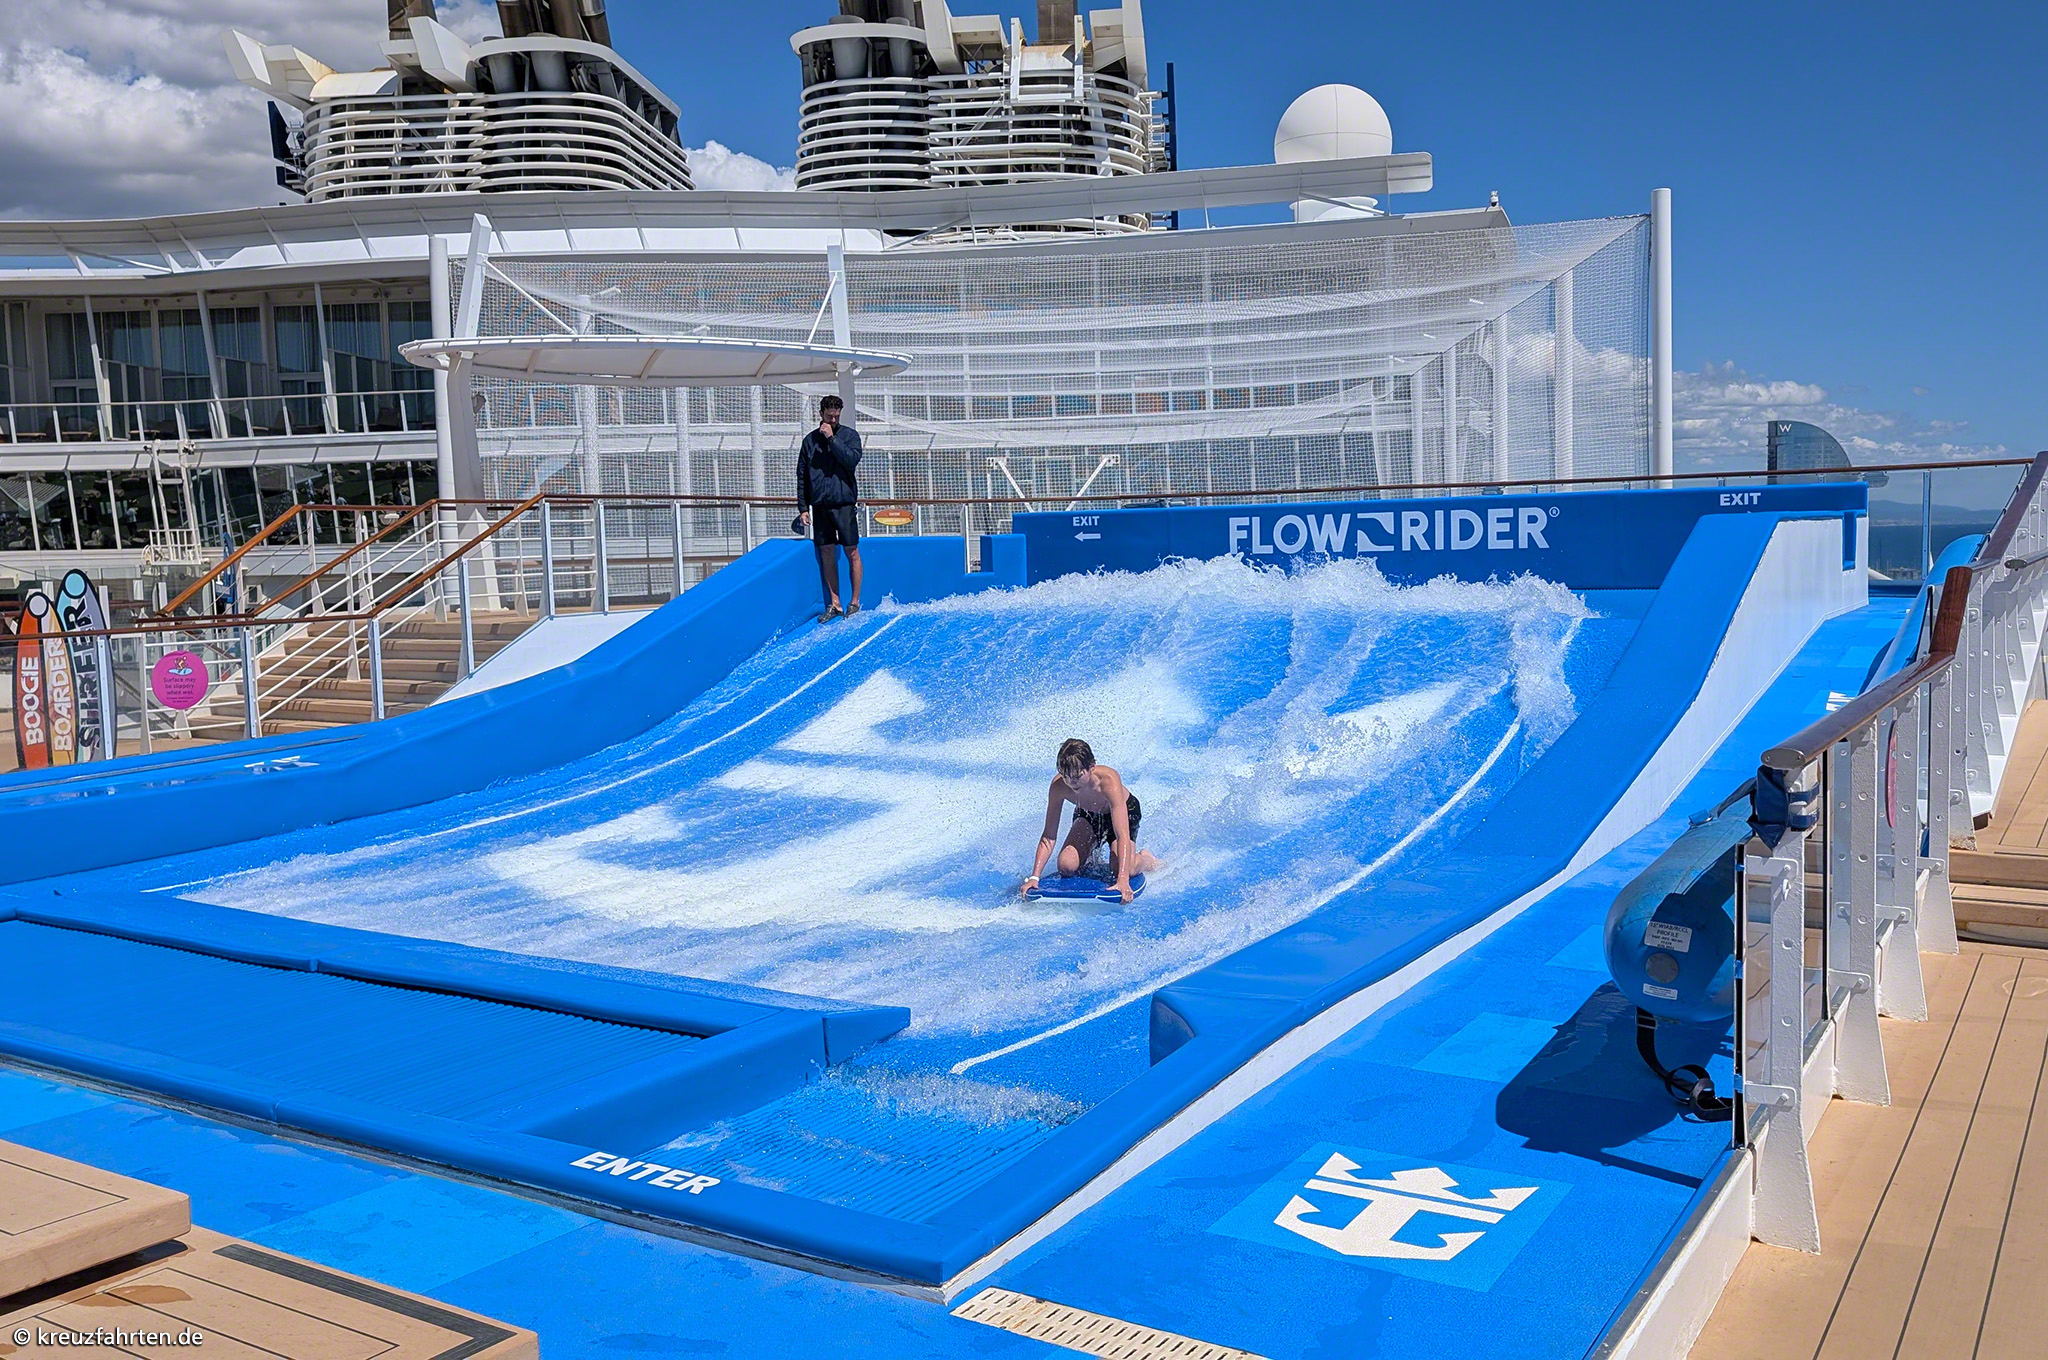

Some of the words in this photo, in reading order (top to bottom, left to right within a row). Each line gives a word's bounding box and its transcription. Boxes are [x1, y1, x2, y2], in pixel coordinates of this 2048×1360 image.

[1779, 423, 1792, 433] W
[1719, 492, 1761, 506] EXIT
[1072, 516, 1100, 527] EXIT
[1229, 513, 1352, 555] FLOW
[63, 596, 101, 750] SURFER
[20, 656, 44, 746] BOOGIE
[1656, 929, 1679, 938] PROFILE
[570, 1151, 721, 1195] ENTER
